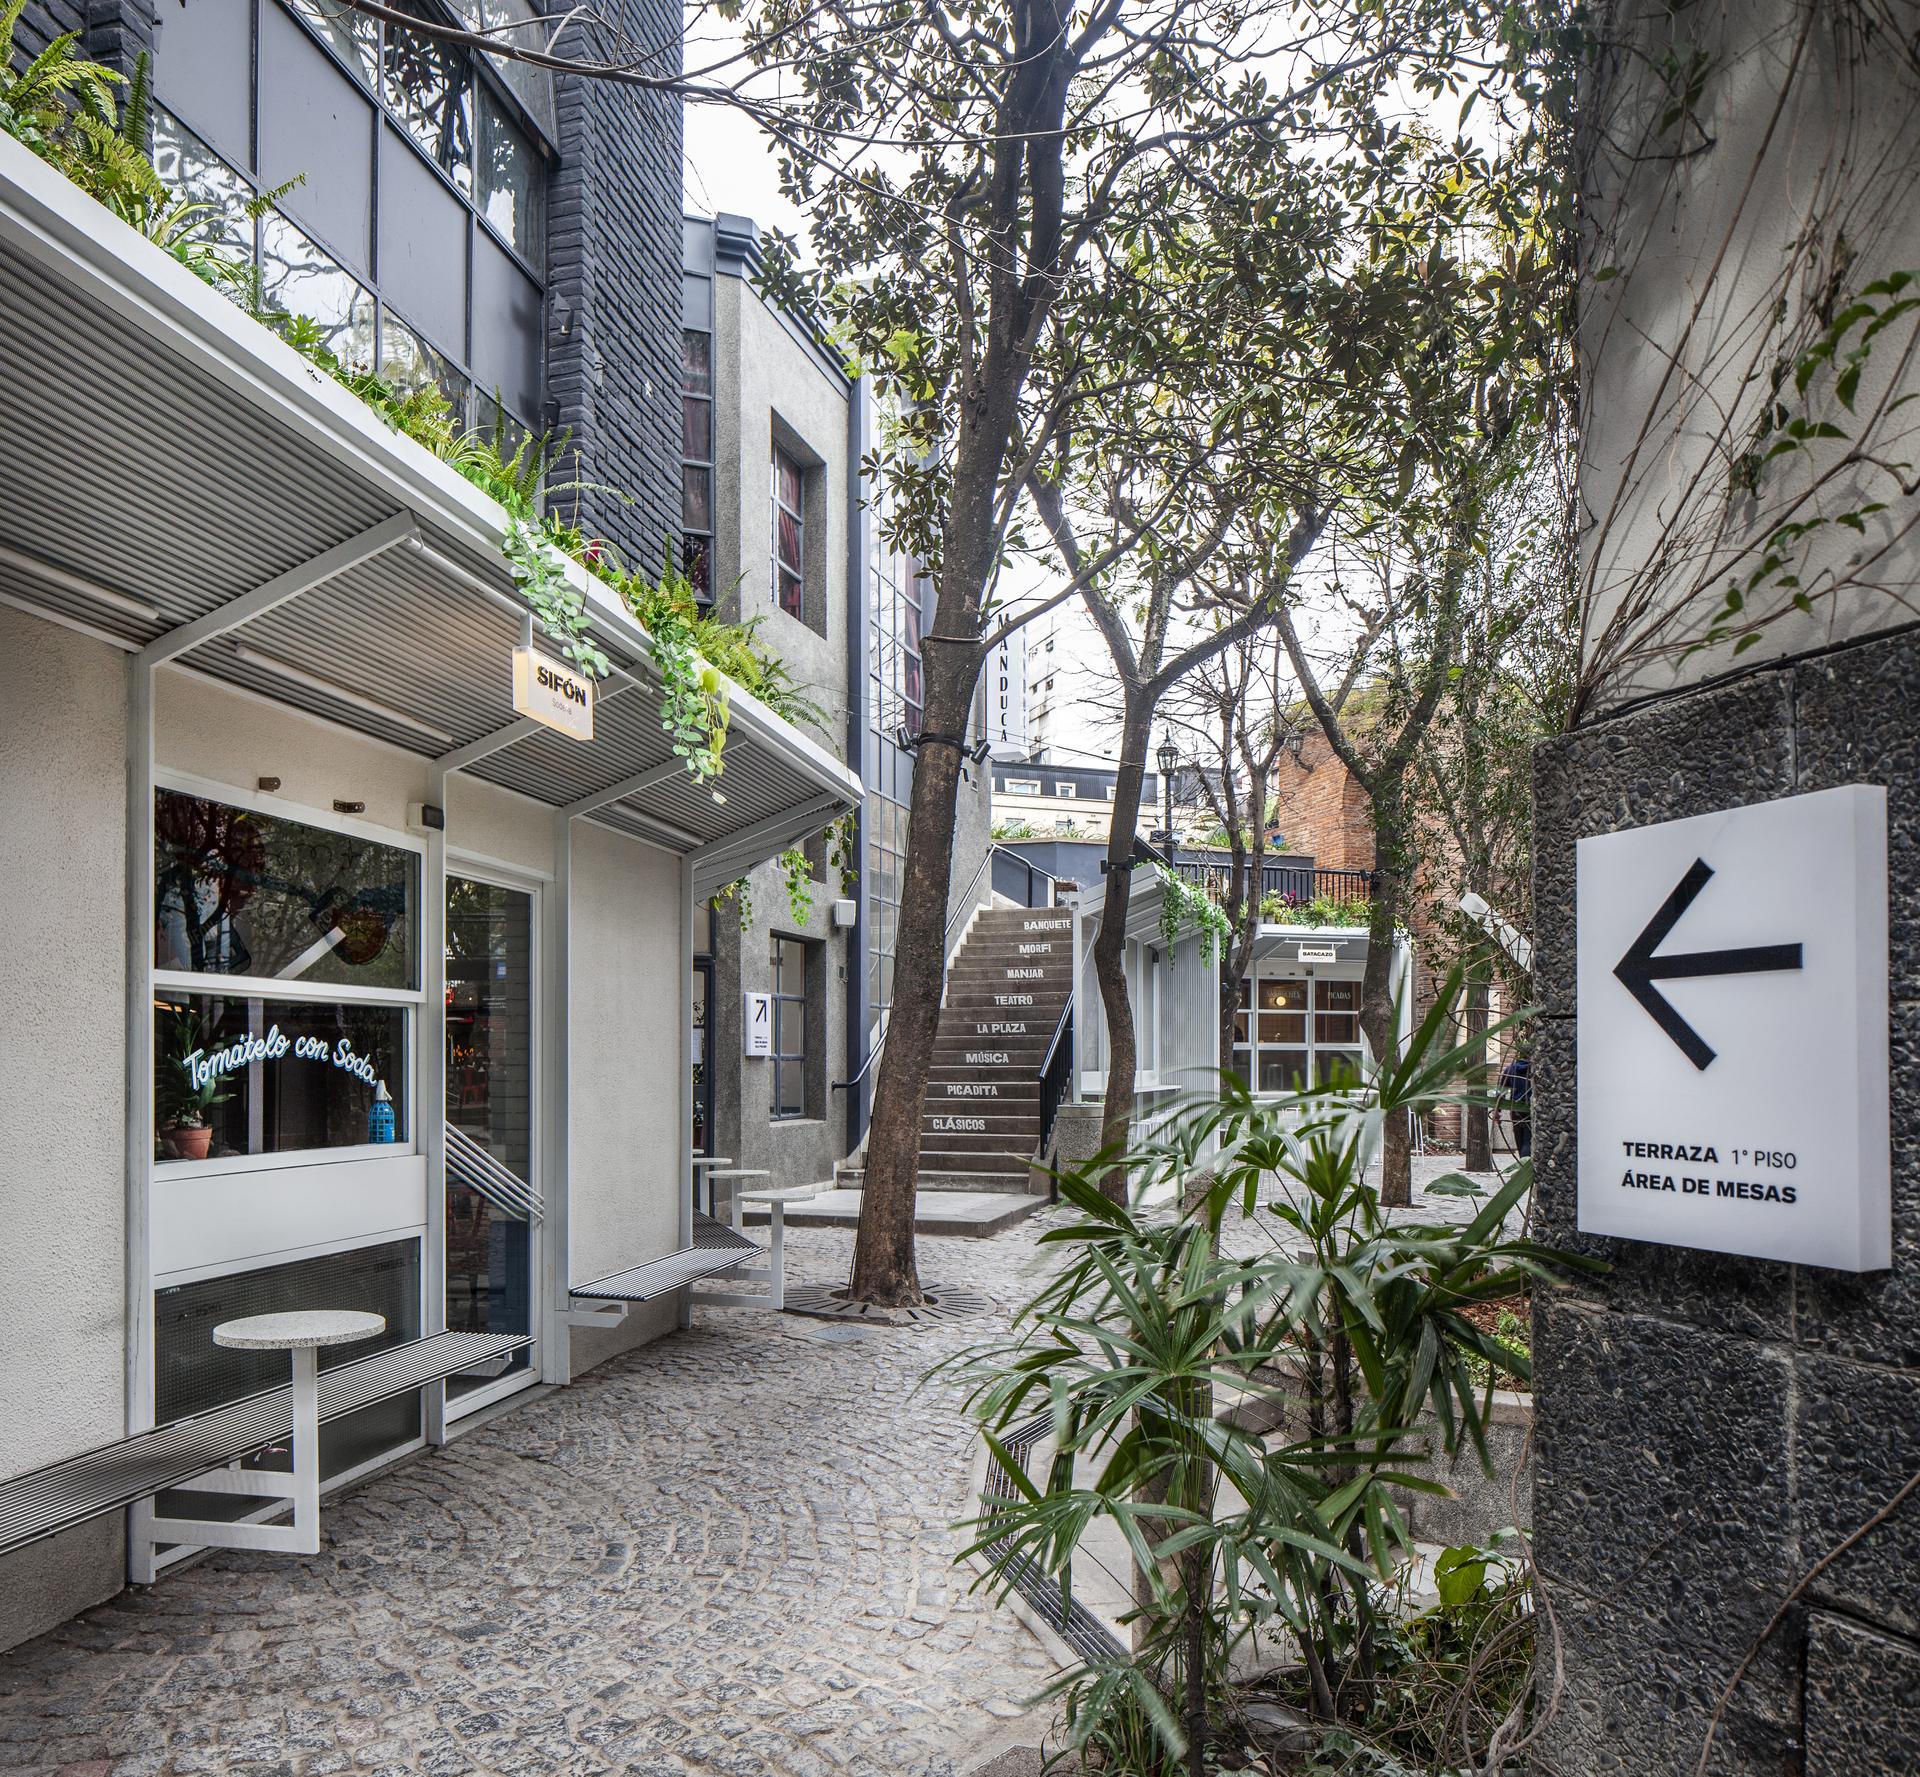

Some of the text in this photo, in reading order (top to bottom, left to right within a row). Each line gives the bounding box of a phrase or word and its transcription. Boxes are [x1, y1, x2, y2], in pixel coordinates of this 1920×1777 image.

[537, 665, 586, 707] SIFÓN
[1024, 920, 1072, 930] BANQUETE
[1019, 943, 1051, 954] MORFI
[1007, 968, 1044, 979] MANJAR
[994, 995, 1033, 1006] TEATRO
[1327, 991, 1351, 1000] PICADAS
[977, 1023, 1026, 1034] LA PLAZA
[183, 1024, 377, 1091] Tomátelo con Soda
[966, 1051, 1009, 1064] MÚSICA
[947, 1085, 998, 1096] PICADITA
[933, 1117, 986, 1131] CLÁSICOS
[1622, 1141, 1797, 1169] TERRAZA 1° PISO
[1621, 1169, 1797, 1204] ÁREA DE MESAS
